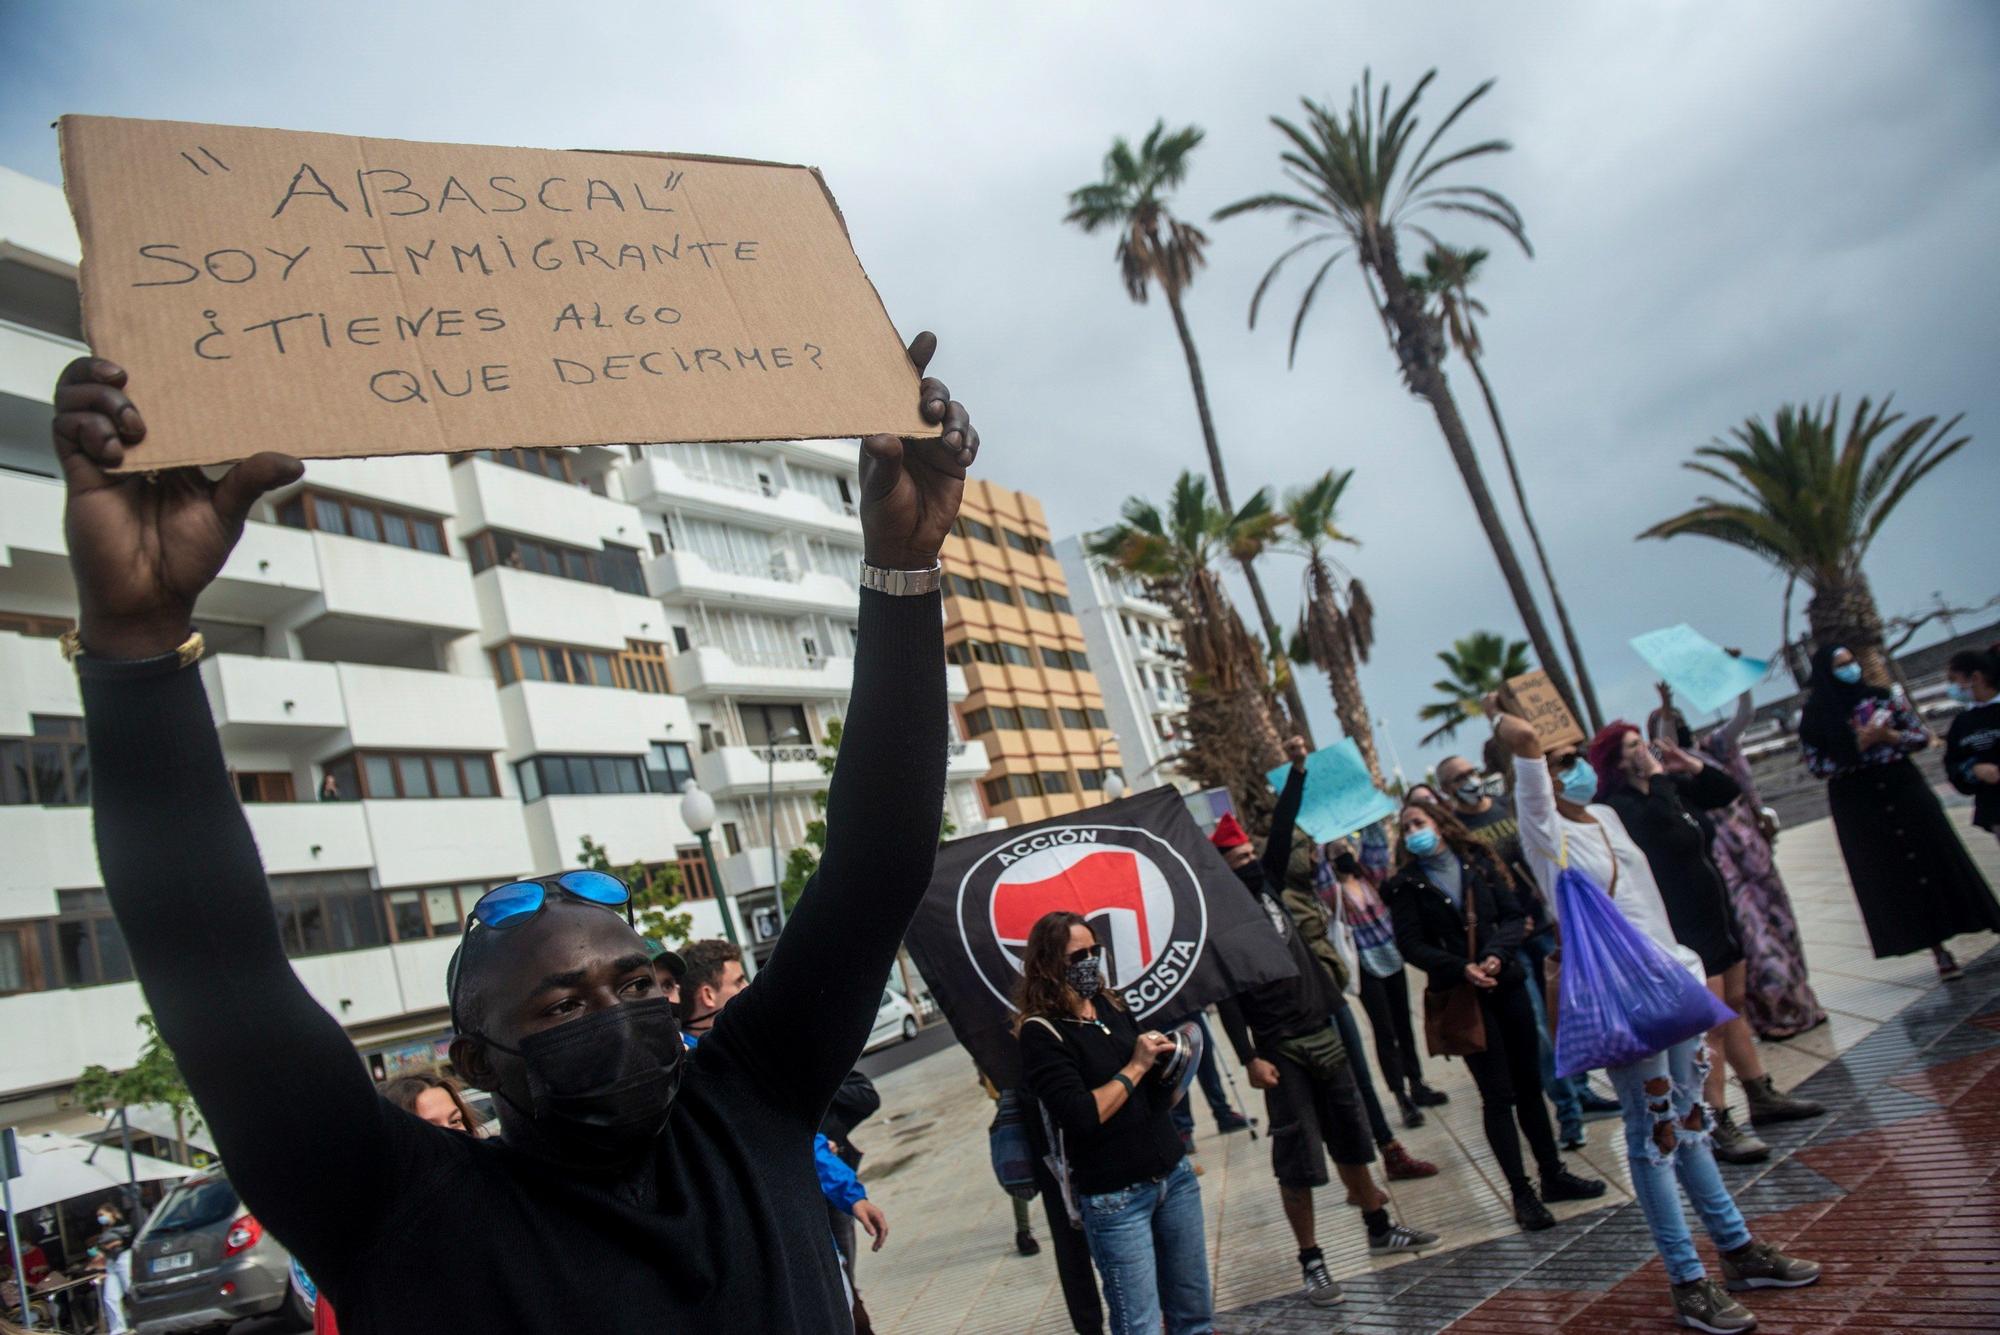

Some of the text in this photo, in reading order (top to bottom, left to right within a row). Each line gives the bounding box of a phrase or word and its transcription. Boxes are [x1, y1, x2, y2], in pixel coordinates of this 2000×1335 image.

[131, 244, 310, 287] SOY
[194, 302, 682, 359] ¿TIENES ALGO
[369, 343, 824, 403] QUE DECIRME?
[997, 828, 1098, 867] ACCIÓN
[1124, 941, 1196, 1013] SCISTA
